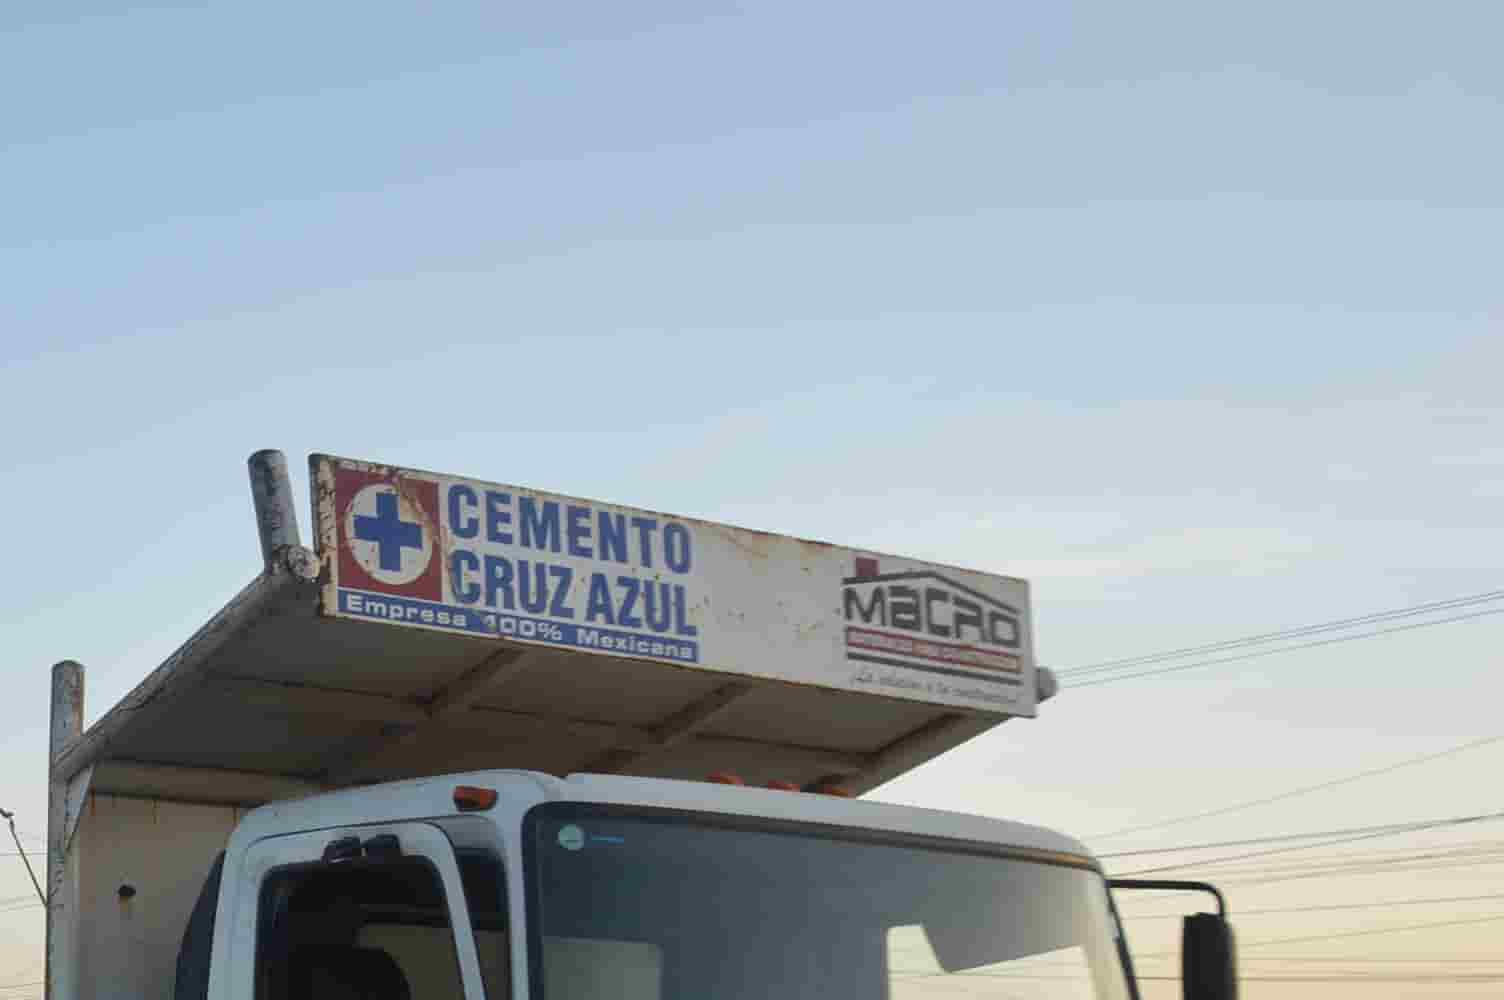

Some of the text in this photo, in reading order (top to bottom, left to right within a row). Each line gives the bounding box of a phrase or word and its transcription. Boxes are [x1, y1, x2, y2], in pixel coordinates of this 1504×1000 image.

[446, 483, 693, 575] CEMENTO
[345, 594, 694, 660] Empresa 100% Mexicana
[449, 549, 700, 637] CRUZ AZUL
